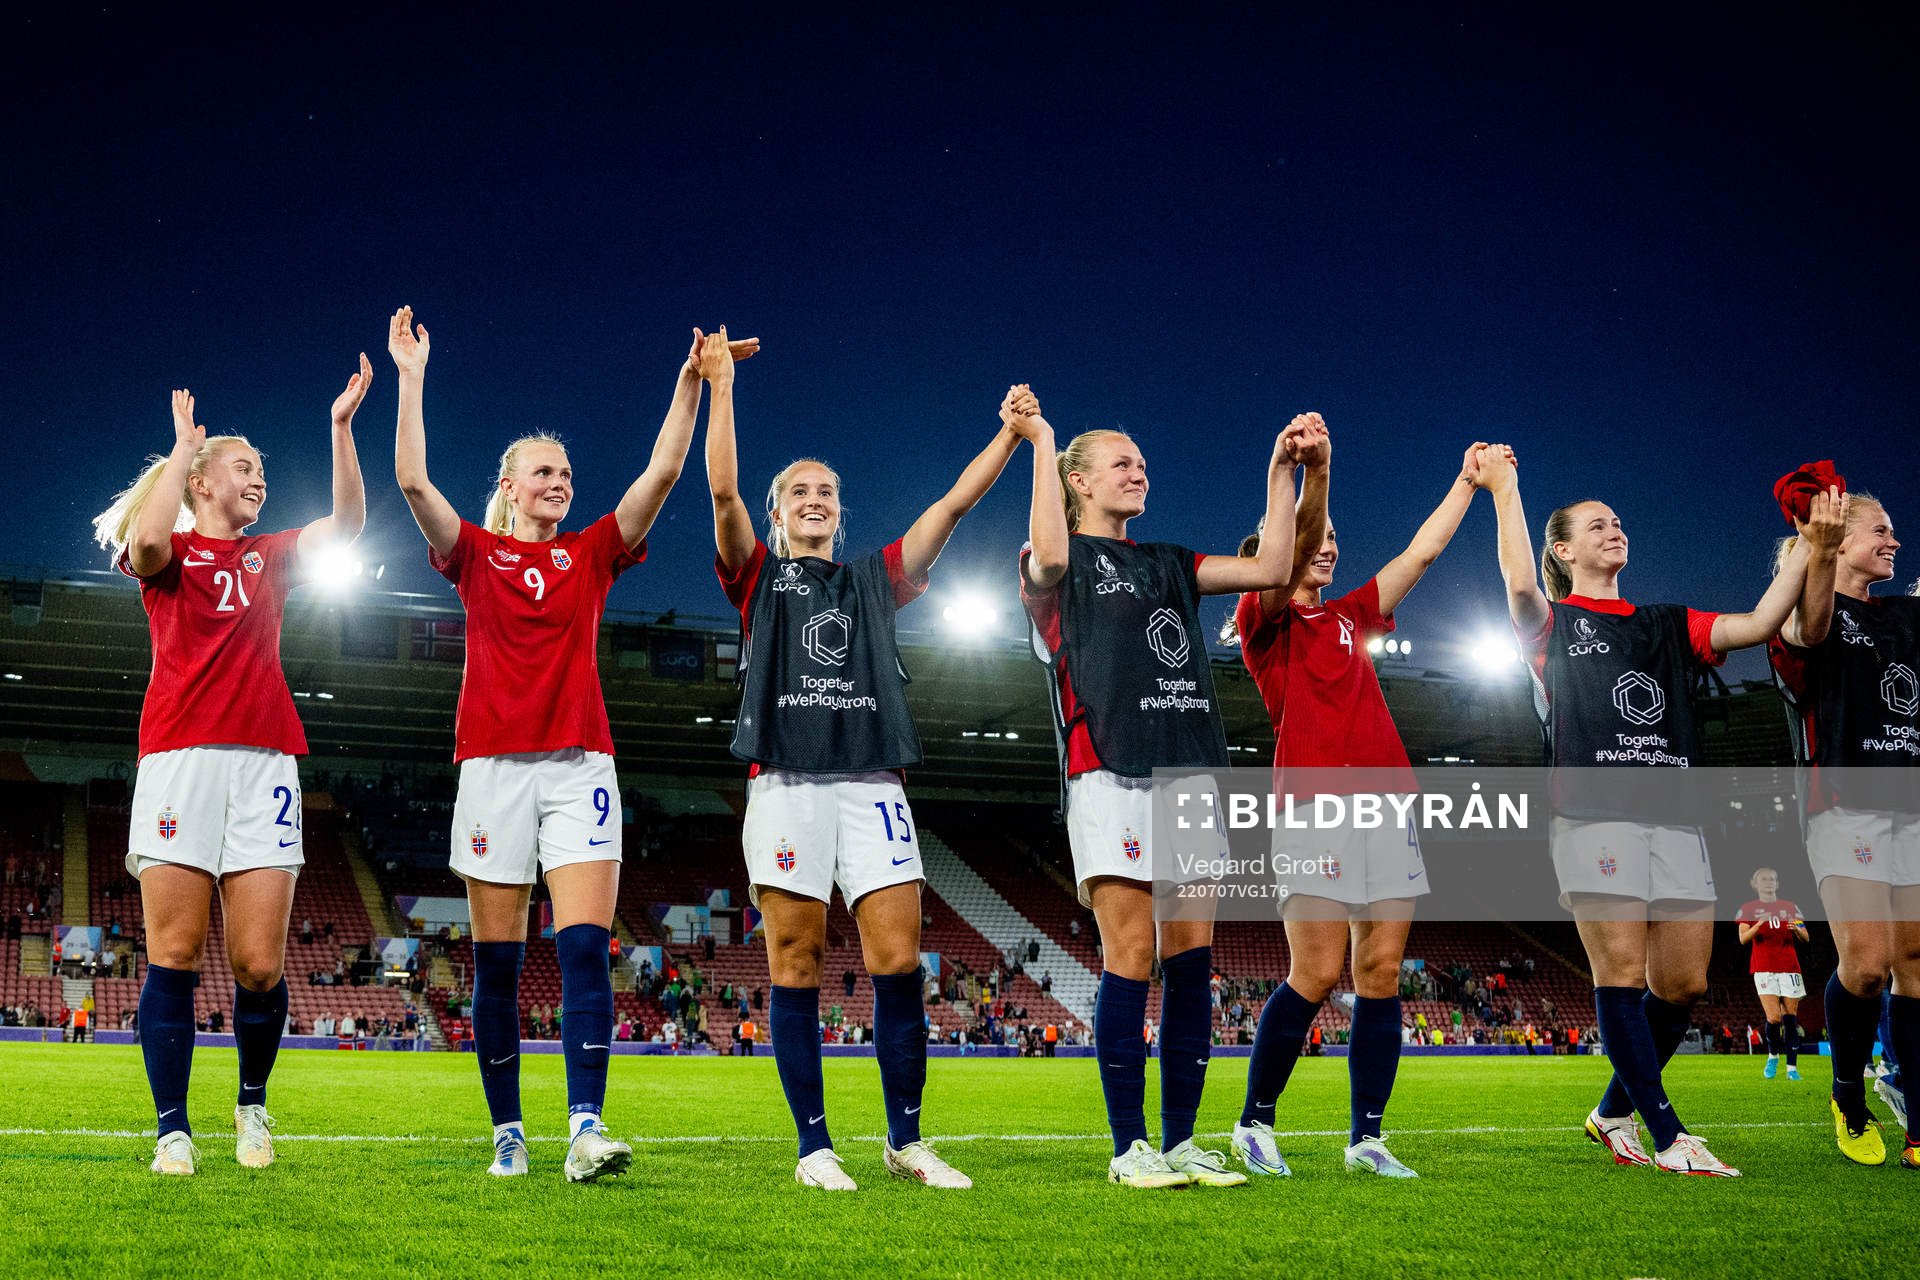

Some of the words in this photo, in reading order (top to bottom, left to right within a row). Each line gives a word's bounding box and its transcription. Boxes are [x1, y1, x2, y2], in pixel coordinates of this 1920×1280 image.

[213, 569, 251, 612] 21
[523, 567, 545, 601] 9
[1338, 619, 1353, 656] 4
[1155, 677, 1197, 694] Together
[777, 692, 877, 712] #WePlayStrong
[1139, 694, 1210, 713] #WePlayStrong
[1615, 733, 1668, 749] Together
[1595, 748, 1689, 770] #WePlayStrong
[593, 787, 610, 827] 9
[874, 801, 912, 843] 15
[1407, 817, 1420, 858] 4
[1768, 915, 1781, 929] 10
[1789, 974, 1801, 987] 10
